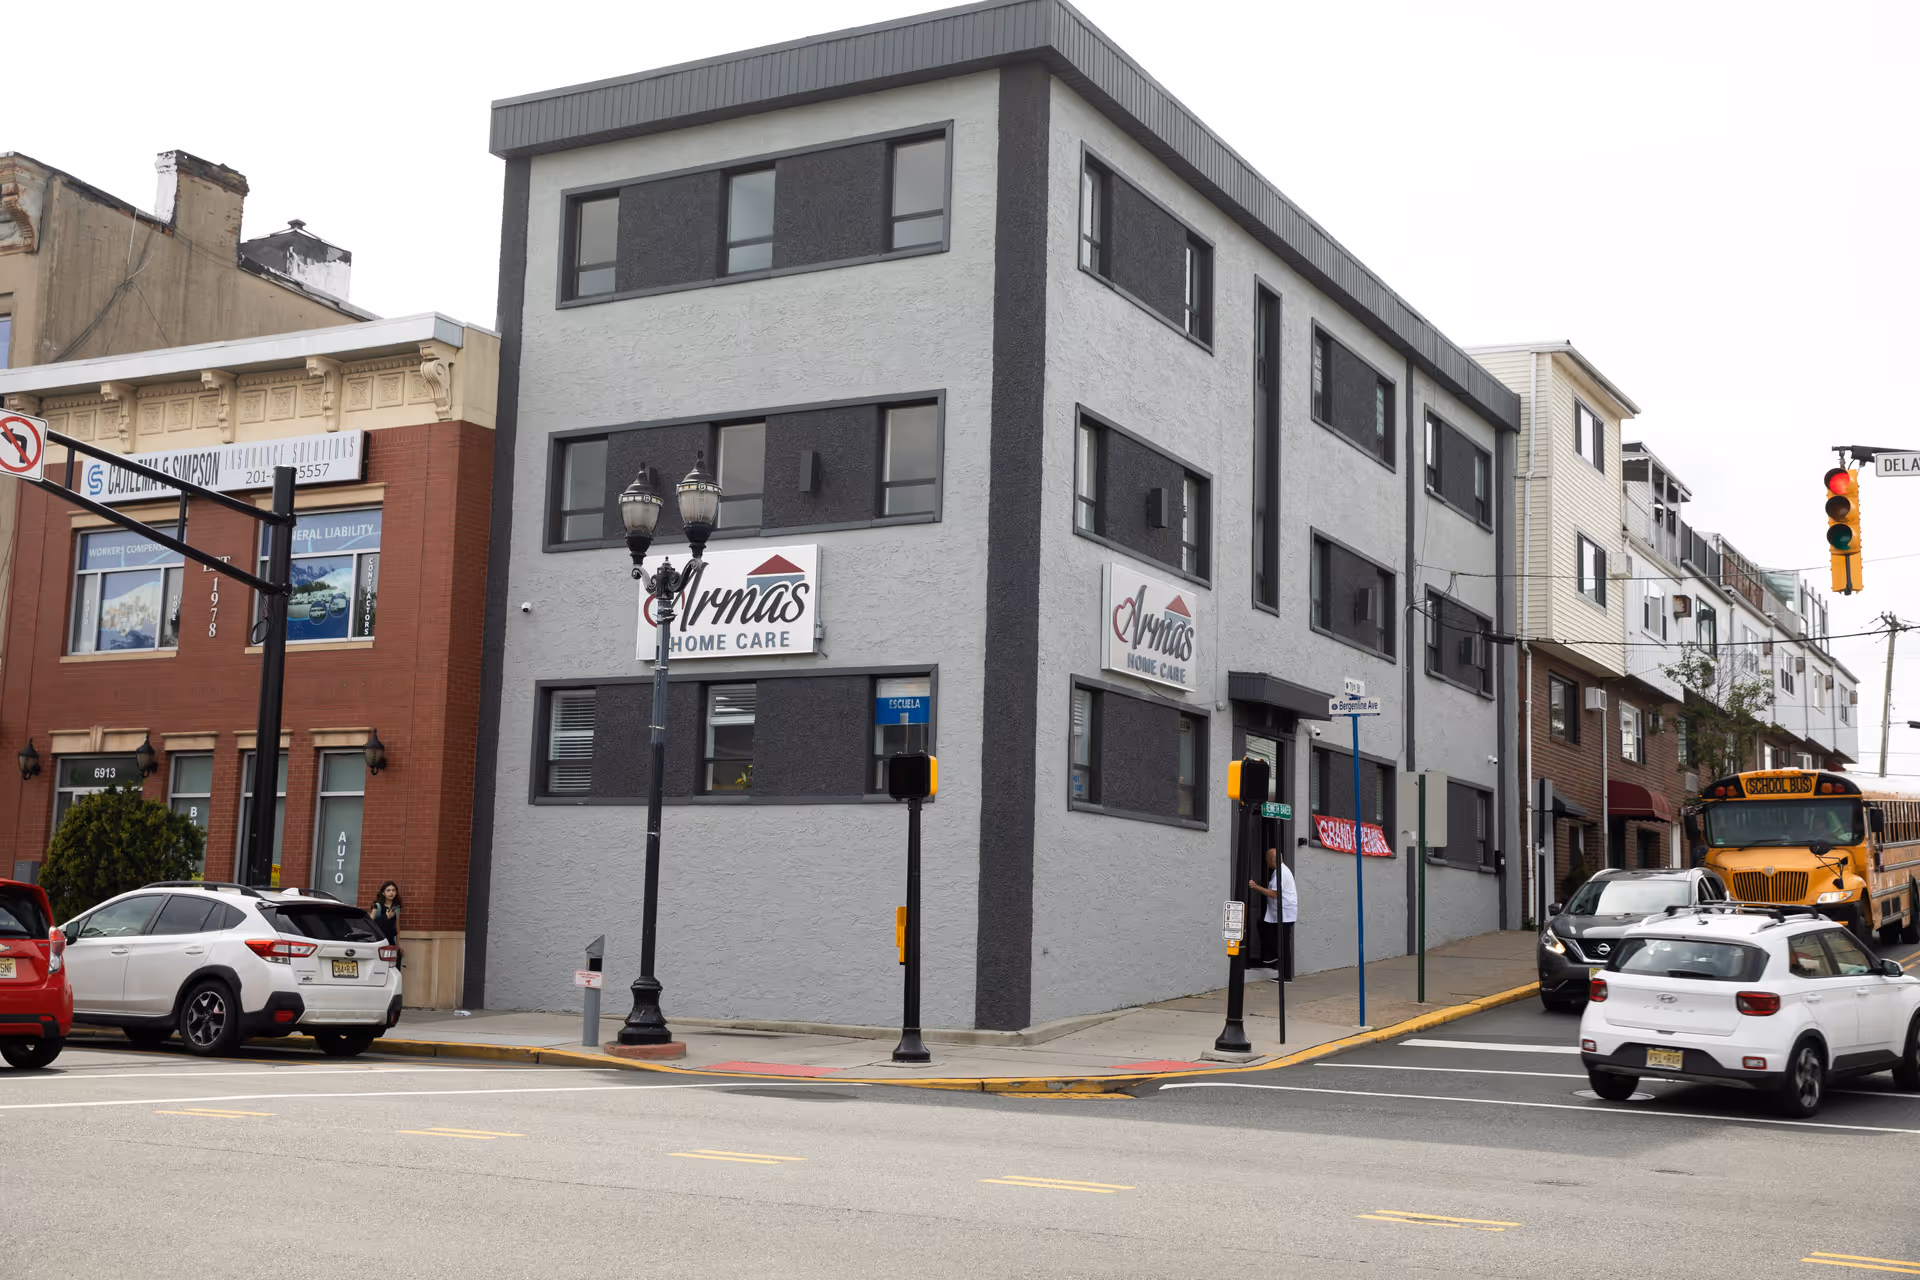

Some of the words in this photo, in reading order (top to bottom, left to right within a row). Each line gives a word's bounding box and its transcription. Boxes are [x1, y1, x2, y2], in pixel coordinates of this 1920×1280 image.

[172, 451, 220, 489] SIMPSON
[246, 463, 329, 484] 201--5557
[1884, 458, 1920, 472] DELA
[325, 524, 374, 539] LIABILITY
[89, 546, 124, 557] WORKERS
[364, 557, 375, 635] CONTRACTORS
[671, 561, 810, 632] Armas
[208, 577, 219, 637] 1978
[1121, 584, 1194, 662] Armas
[671, 634, 726, 652] HOME
[736, 631, 790, 648] CARE
[1128, 652, 1157, 676] HOME
[1160, 662, 1186, 684] CARE
[889, 698, 921, 709] ESCUELA
[1339, 700, 1367, 712] Bergenline
[1368, 700, 1378, 710] Ave
[94, 767, 116, 778] 6913
[1748, 778, 1787, 794] SCHOOL
[1790, 778, 1811, 792] BUS
[1319, 819, 1352, 850] GRAND
[335, 831, 346, 884] AUTO
